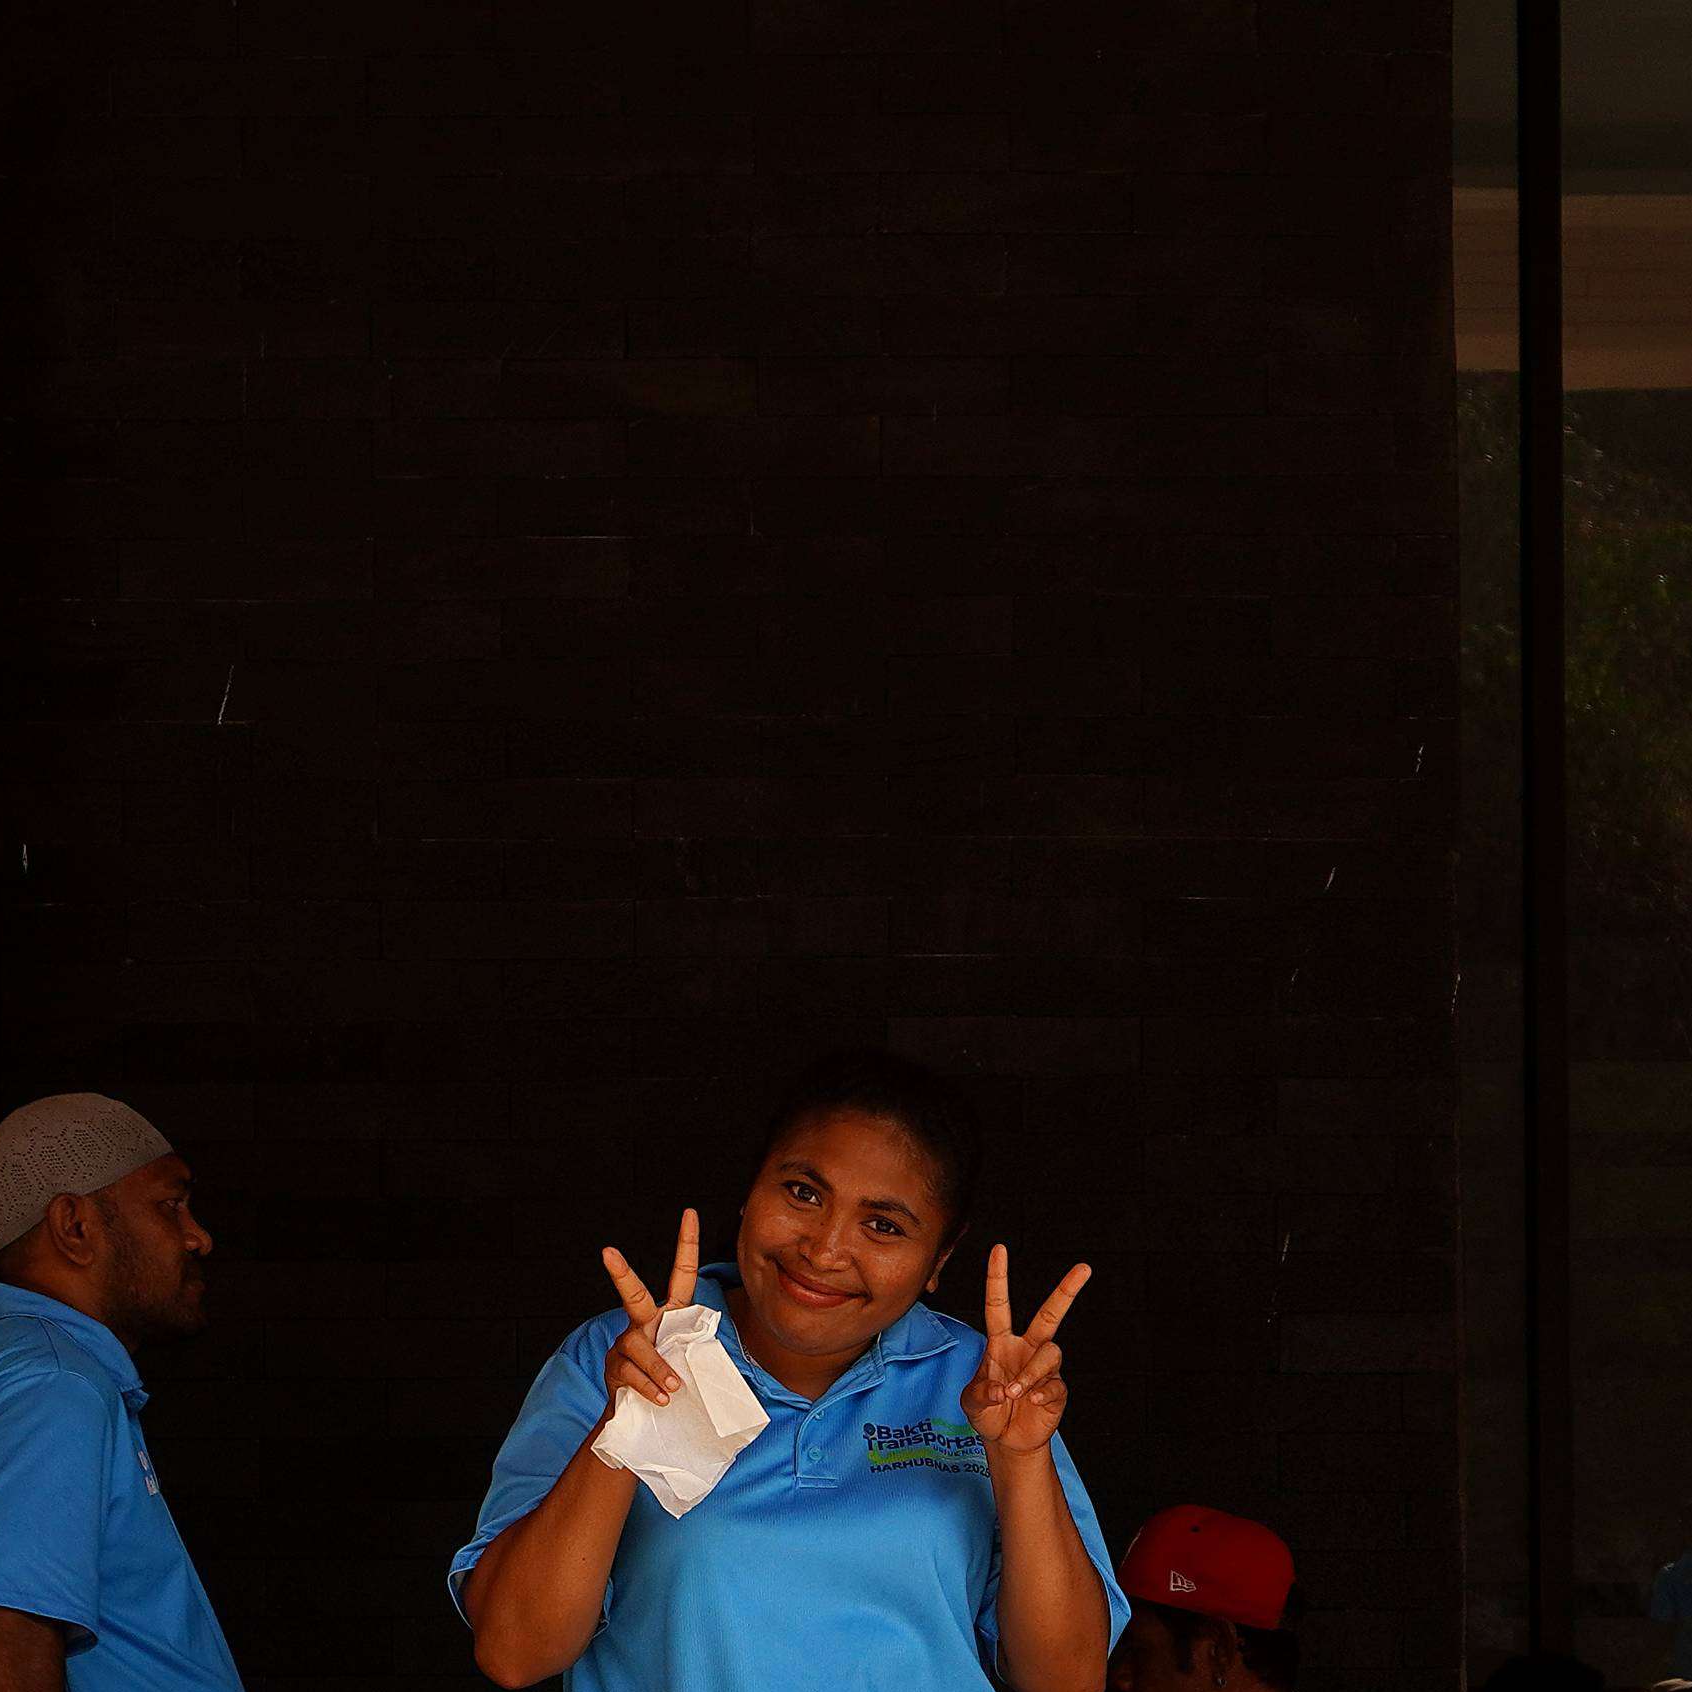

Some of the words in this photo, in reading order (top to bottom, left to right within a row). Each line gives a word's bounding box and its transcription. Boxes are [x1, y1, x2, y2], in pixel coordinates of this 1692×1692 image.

[876, 1418, 933, 1440] Bakti
[863, 1434, 984, 1451] Transportas
[870, 1457, 961, 1474] HARHUBNAS
